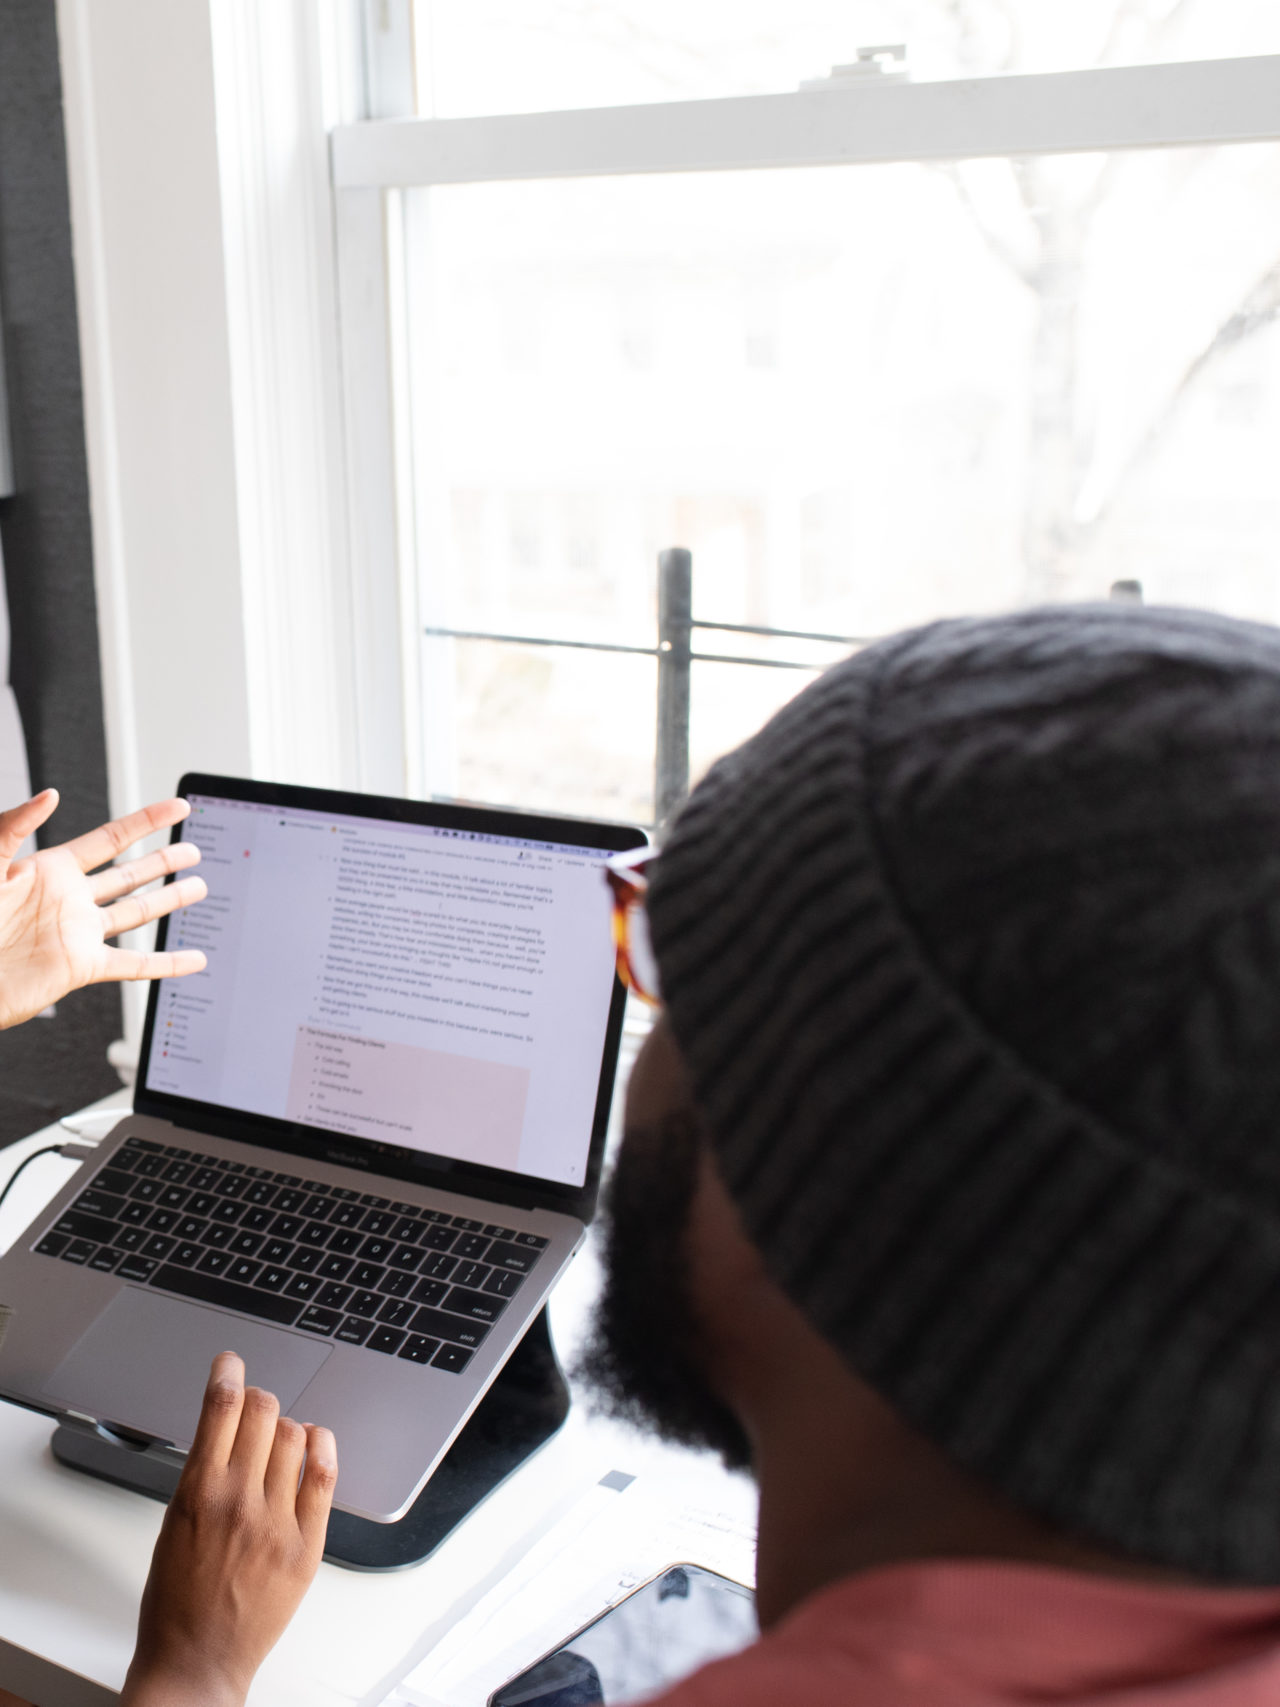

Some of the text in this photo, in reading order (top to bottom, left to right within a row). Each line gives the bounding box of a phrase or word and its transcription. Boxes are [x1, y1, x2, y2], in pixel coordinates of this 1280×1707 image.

[196, 1199, 204, 1207] E
[158, 1215, 166, 1224] S
[185, 1223, 195, 1231] D
[370, 1221, 379, 1229] 9
[310, 1229, 320, 1237] U
[400, 1229, 409, 1237] 0
[242, 1238, 251, 1246] G
[371, 1244, 381, 1253] O
[181, 1249, 191, 1257] C
[402, 1252, 411, 1260] P
[211, 1257, 219, 1265] V
[505, 1258, 524, 1267] delete
[120, 1267, 146, 1278] command
[239, 1265, 248, 1273] B
[361, 1270, 368, 1278] L
[472, 1307, 491, 1316] return
[300, 1319, 330, 1330] command
[339, 1330, 359, 1339] option
[459, 1334, 475, 1342] shift
